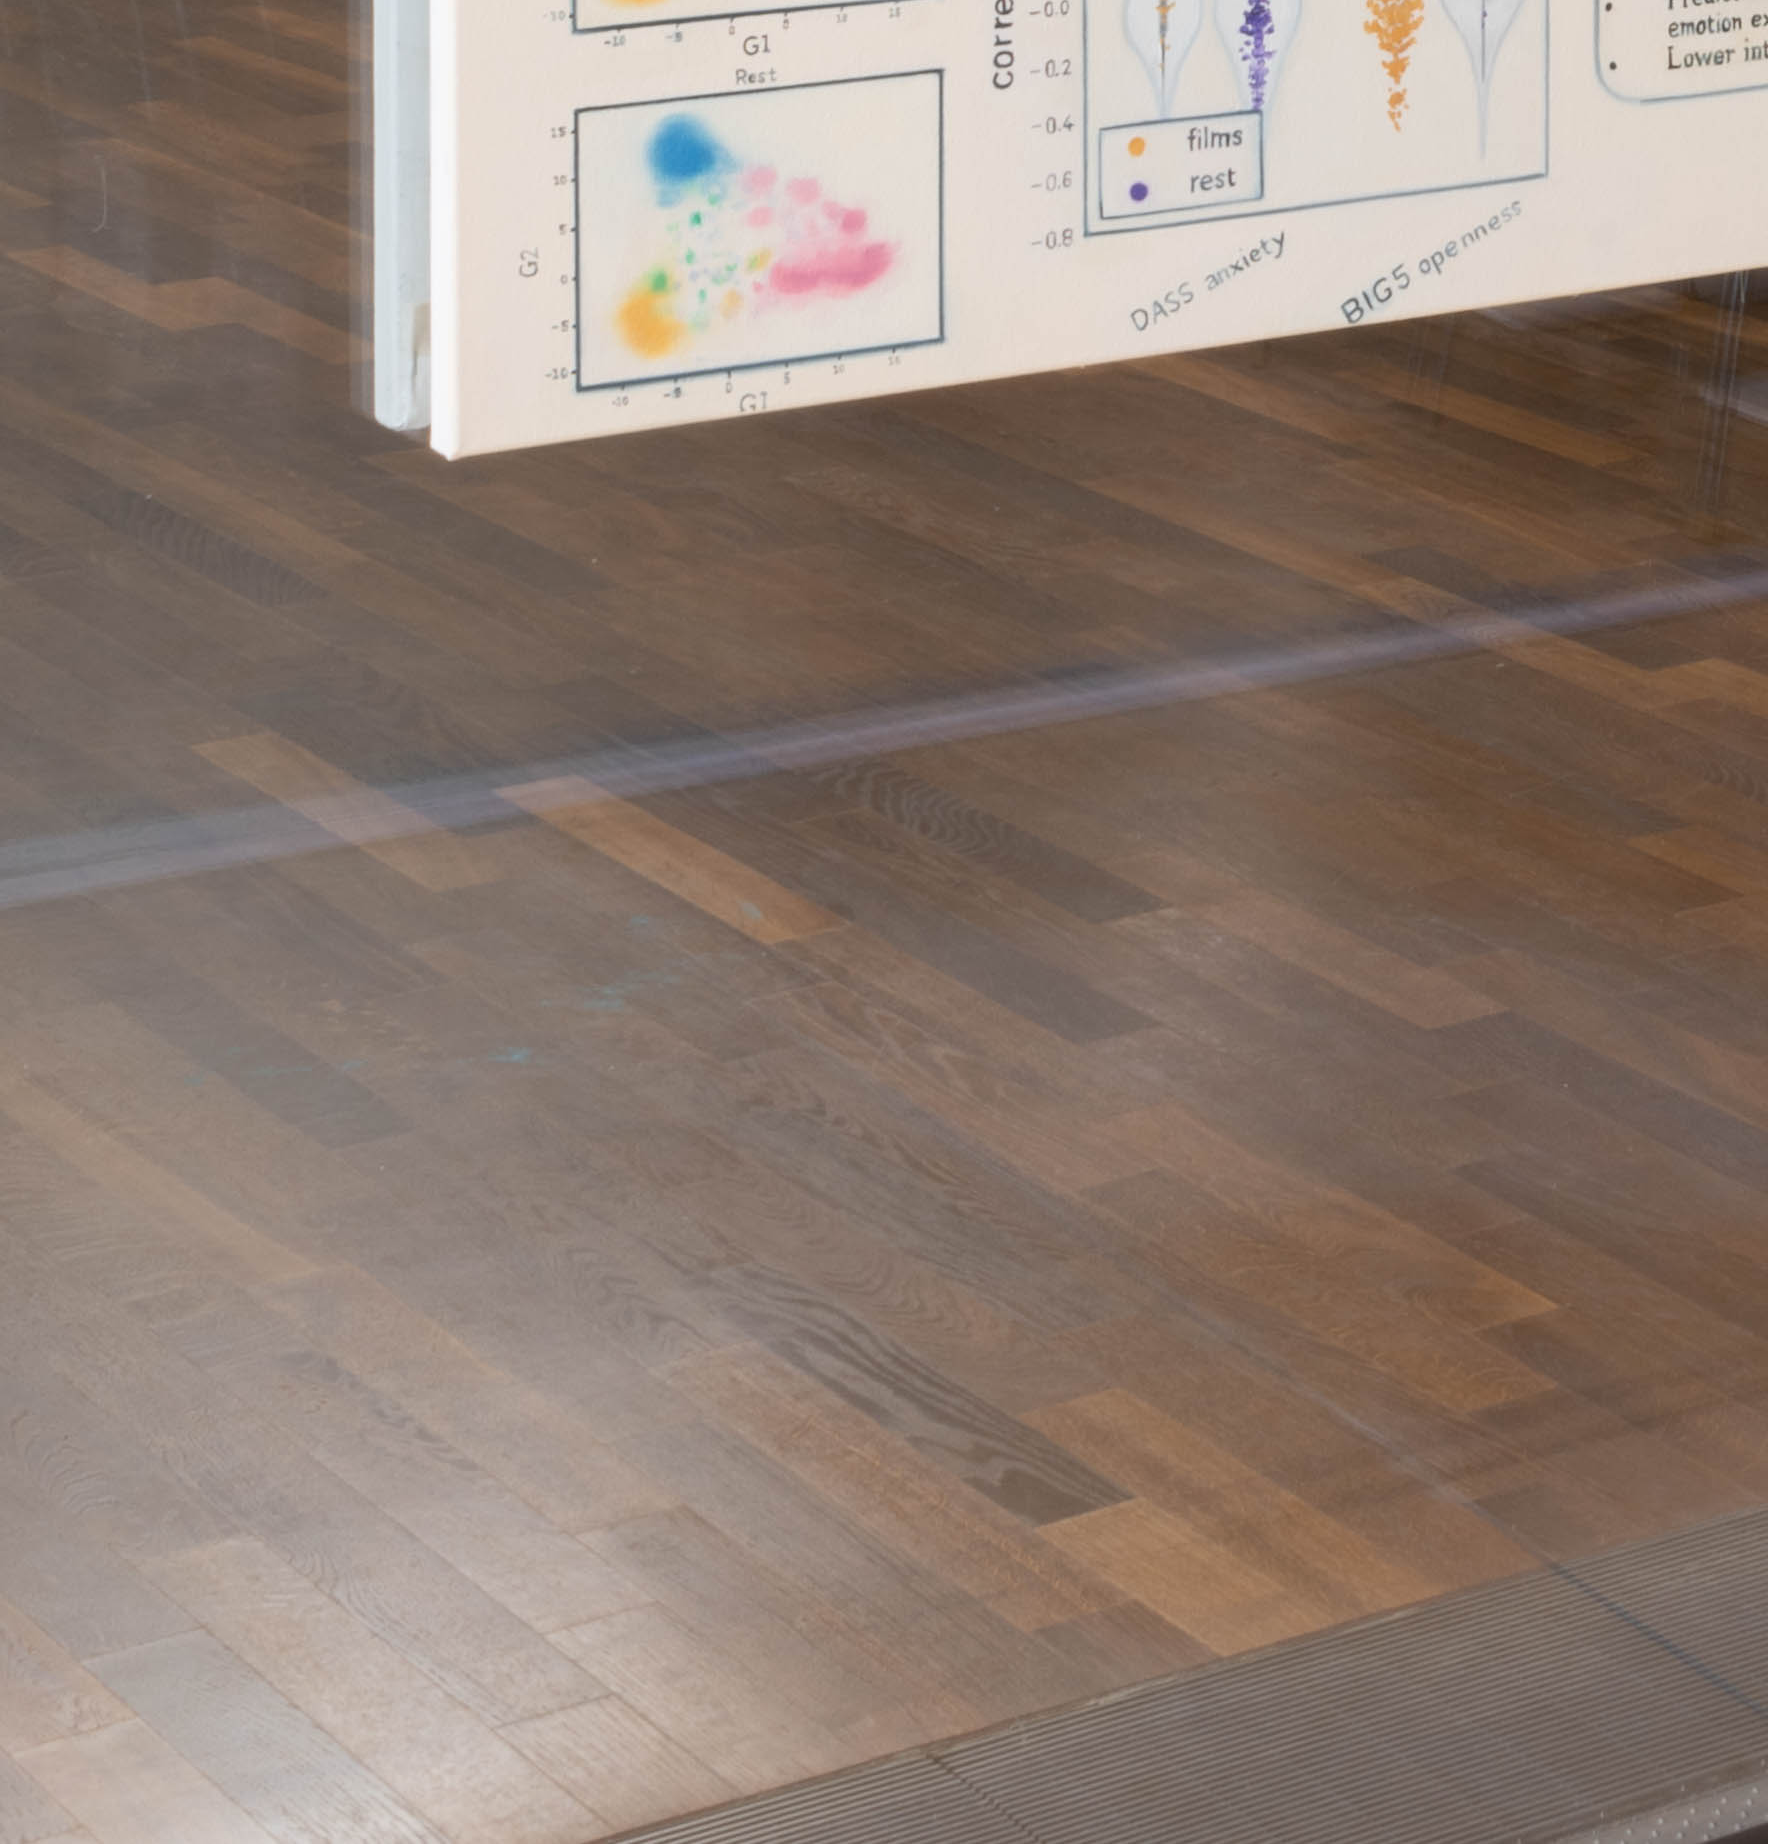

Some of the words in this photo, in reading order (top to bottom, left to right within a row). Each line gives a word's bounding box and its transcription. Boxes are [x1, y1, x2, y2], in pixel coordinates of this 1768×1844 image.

[1187, 126, 1243, 152] films
[1190, 167, 1236, 194] rest
[1418, 200, 1522, 276] openness
[1129, 281, 1195, 332] DASS
[1204, 230, 1285, 291] anxiety
